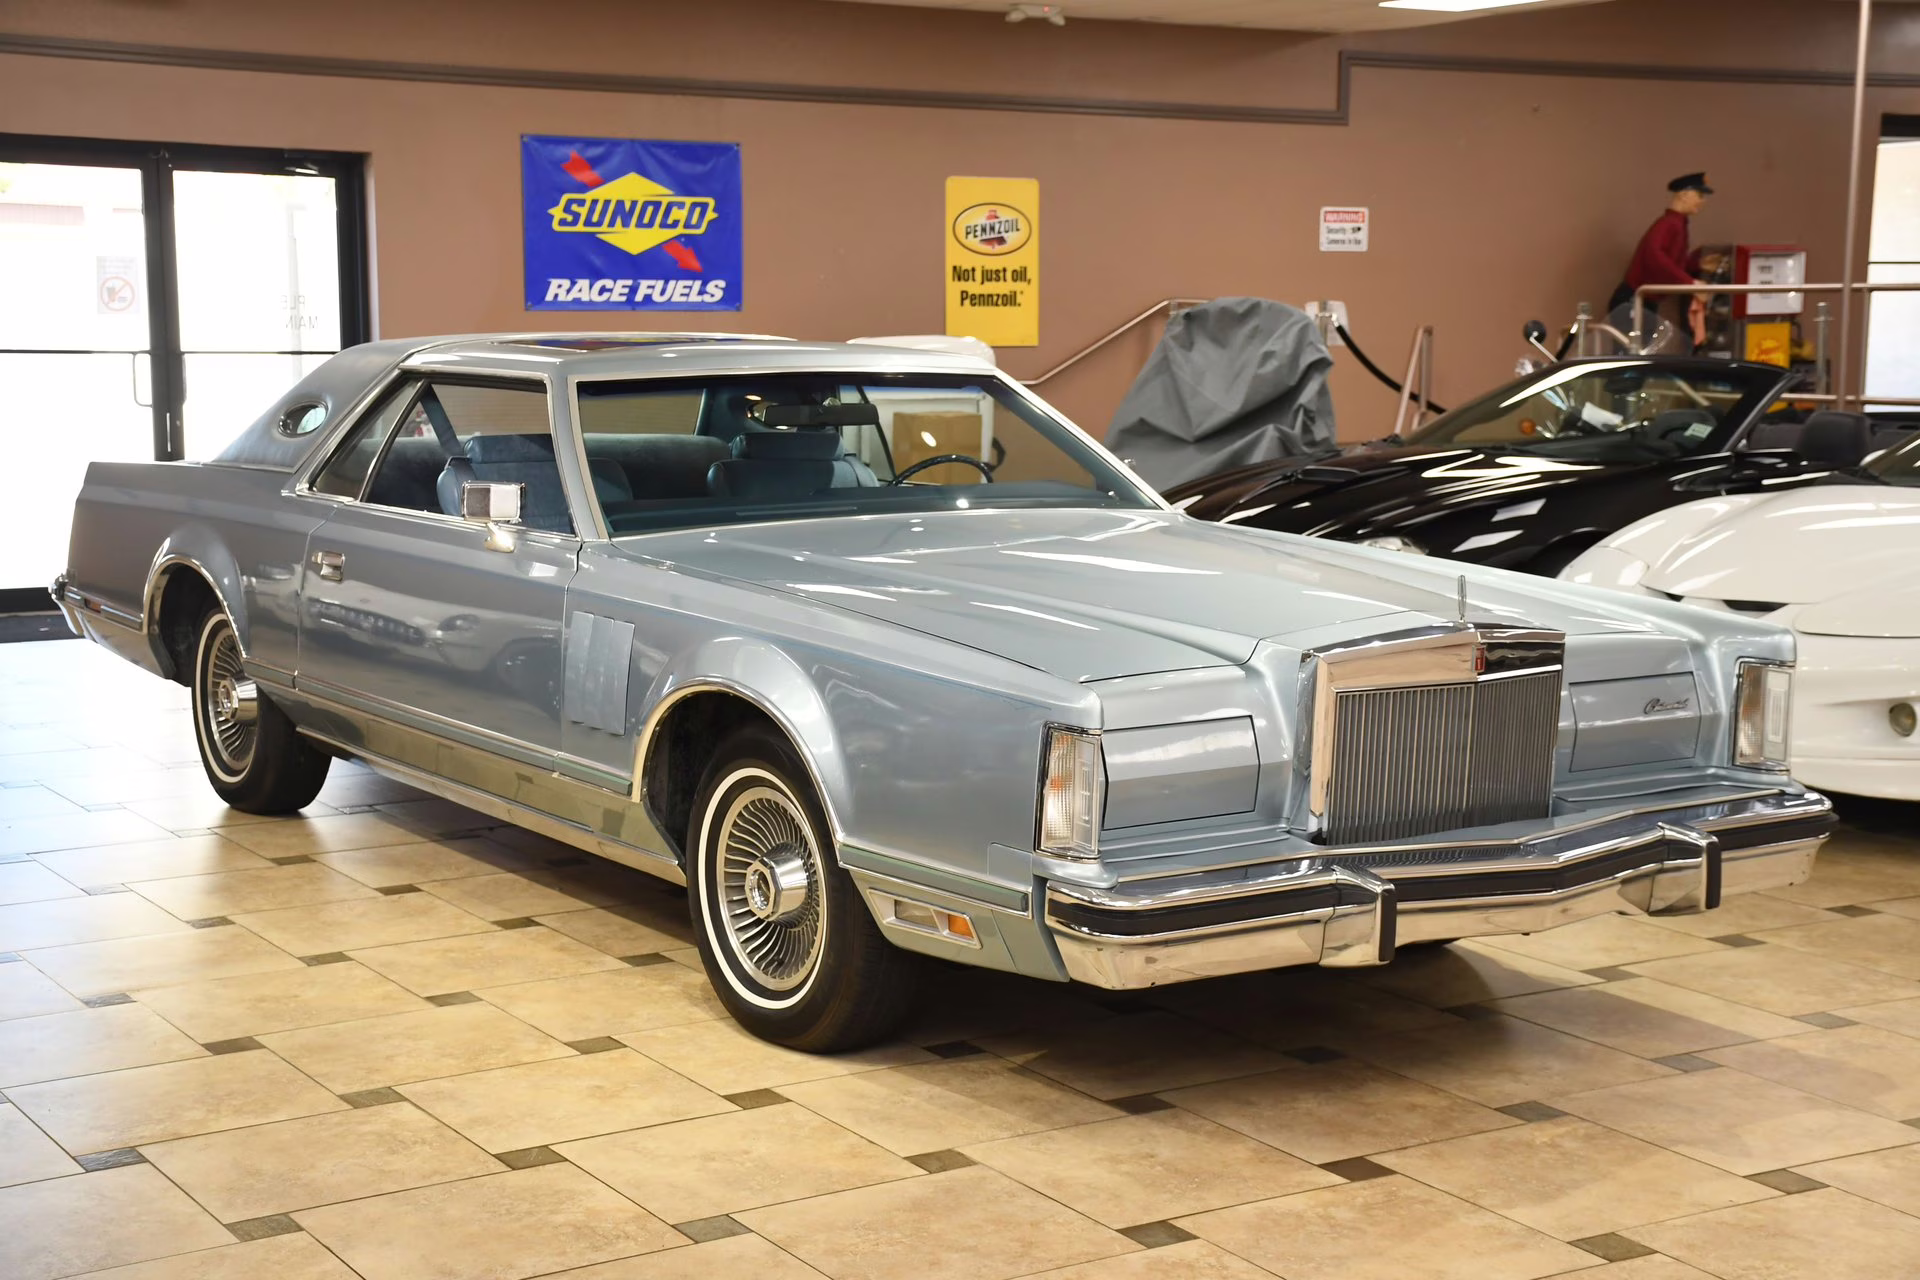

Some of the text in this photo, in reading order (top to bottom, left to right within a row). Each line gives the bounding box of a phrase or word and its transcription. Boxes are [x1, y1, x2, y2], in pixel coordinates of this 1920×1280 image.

[557, 198, 710, 230] SUNOCO
[965, 218, 1020, 240] PENNZOIL
[952, 265, 1032, 285] Not just oil,
[544, 278, 727, 303] RACE FUELS
